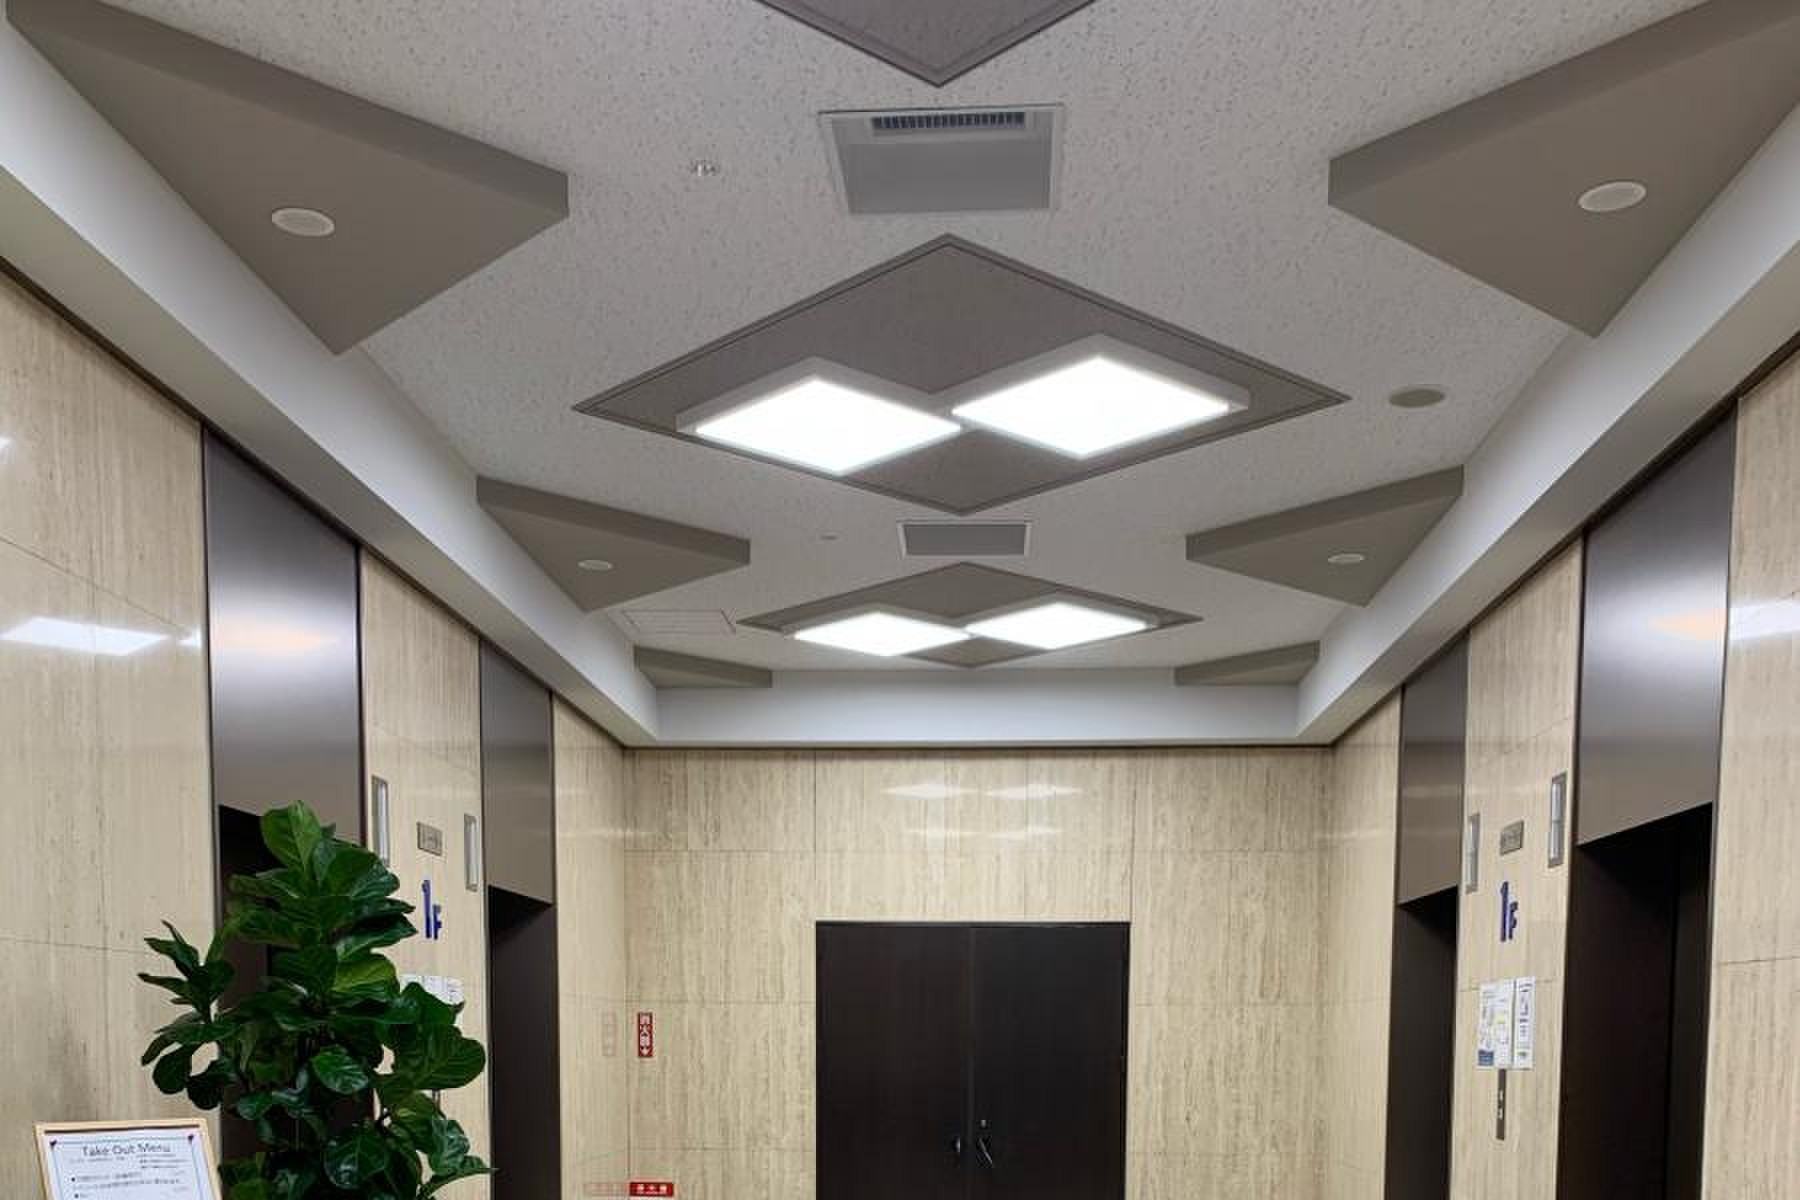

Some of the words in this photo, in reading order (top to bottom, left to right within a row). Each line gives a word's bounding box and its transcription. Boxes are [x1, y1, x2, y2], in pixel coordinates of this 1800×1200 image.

[421, 879, 442, 940] 1F
[1500, 881, 1518, 942] 1F
[83, 1146, 109, 1157] Take
[112, 1144, 135, 1155] Out
[137, 1143, 171, 1154] Menu
